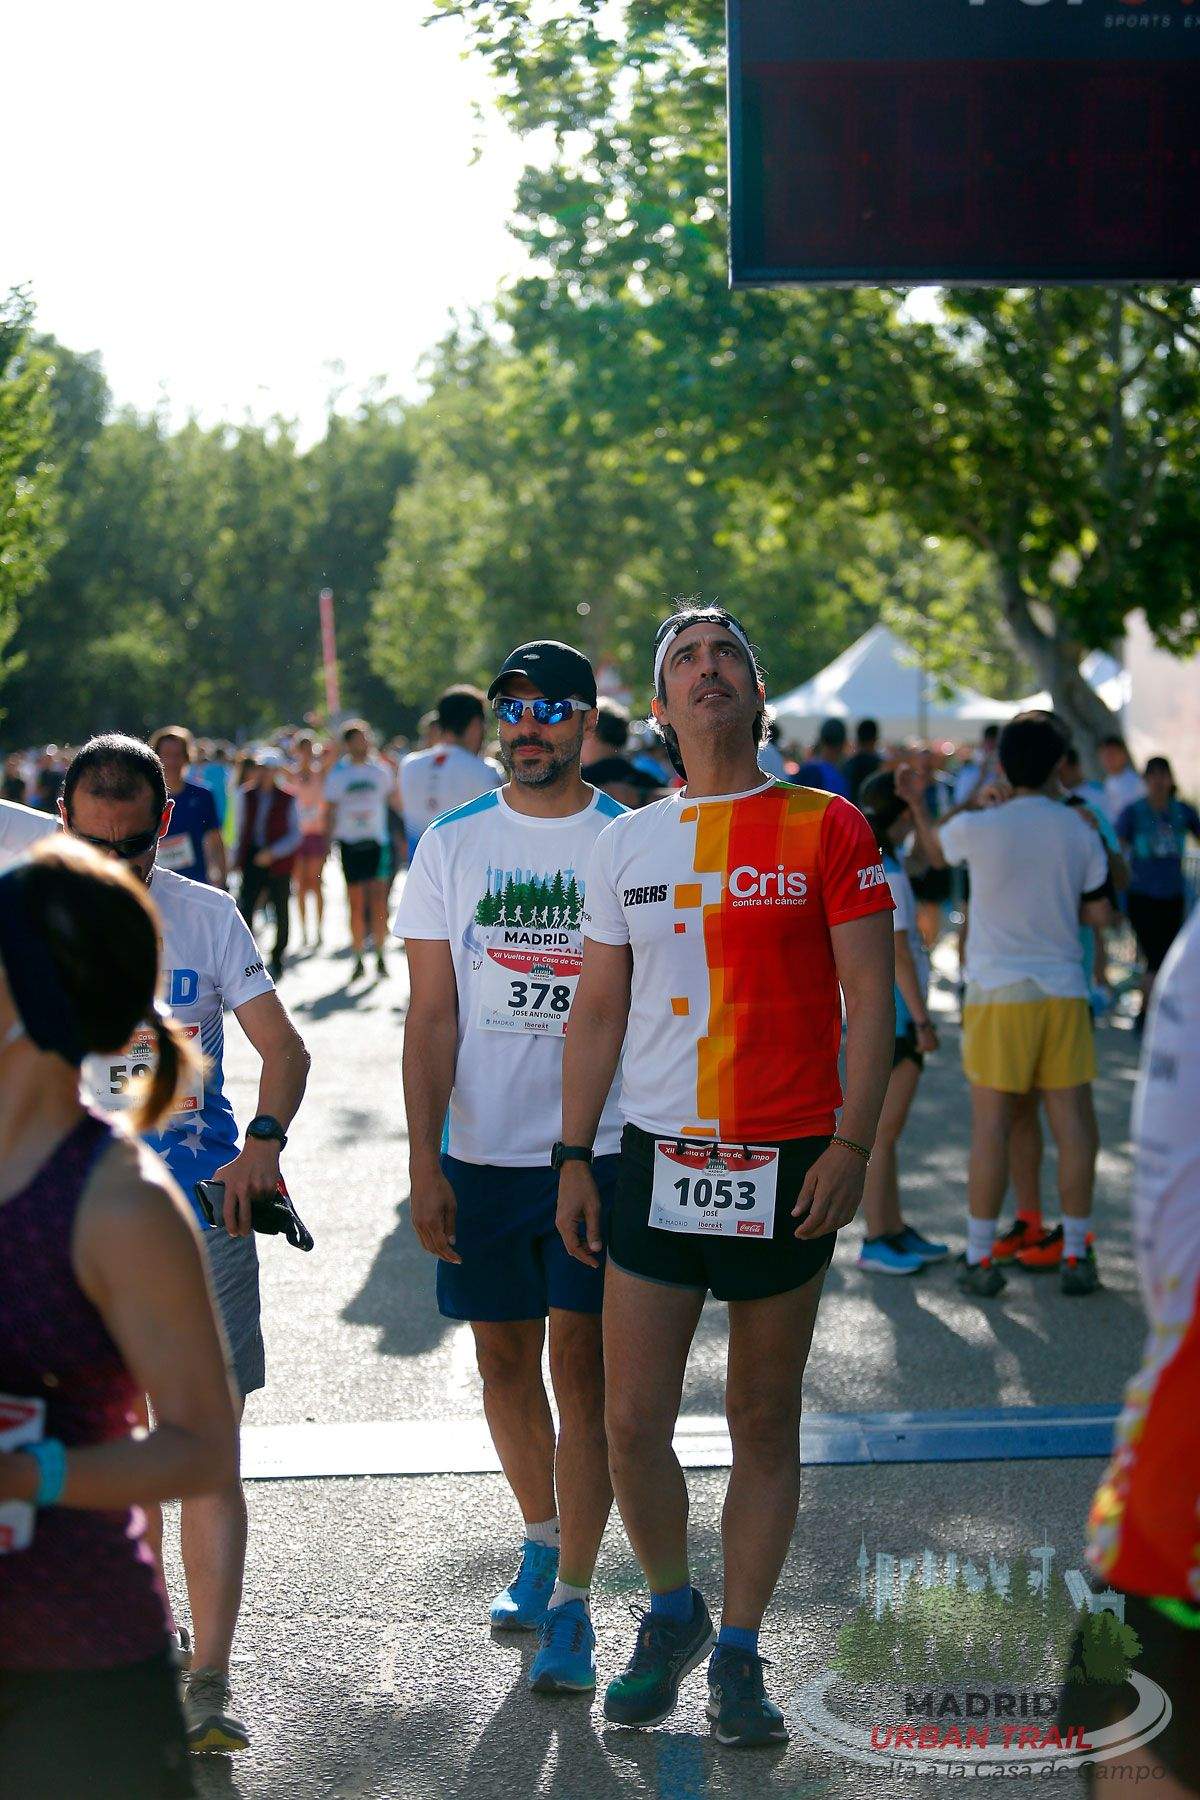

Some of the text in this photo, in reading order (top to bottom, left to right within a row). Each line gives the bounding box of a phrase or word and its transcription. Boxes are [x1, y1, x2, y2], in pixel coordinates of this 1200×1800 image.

[1104, 15, 1171, 28] SPORTS
[729, 864, 807, 897] Cris
[857, 864, 887, 890] 226
[623, 885, 668, 907] 226ERS
[732, 897, 807, 907] contra el cáncer
[504, 931, 569, 945] MADRID
[504, 953, 525, 961] Vuelta
[542, 956, 558, 964] Casa
[560, 957, 569, 965] de
[508, 981, 571, 1012] 378
[529, 1011, 561, 1020] ANTONIO
[673, 1177, 756, 1211] 1053
